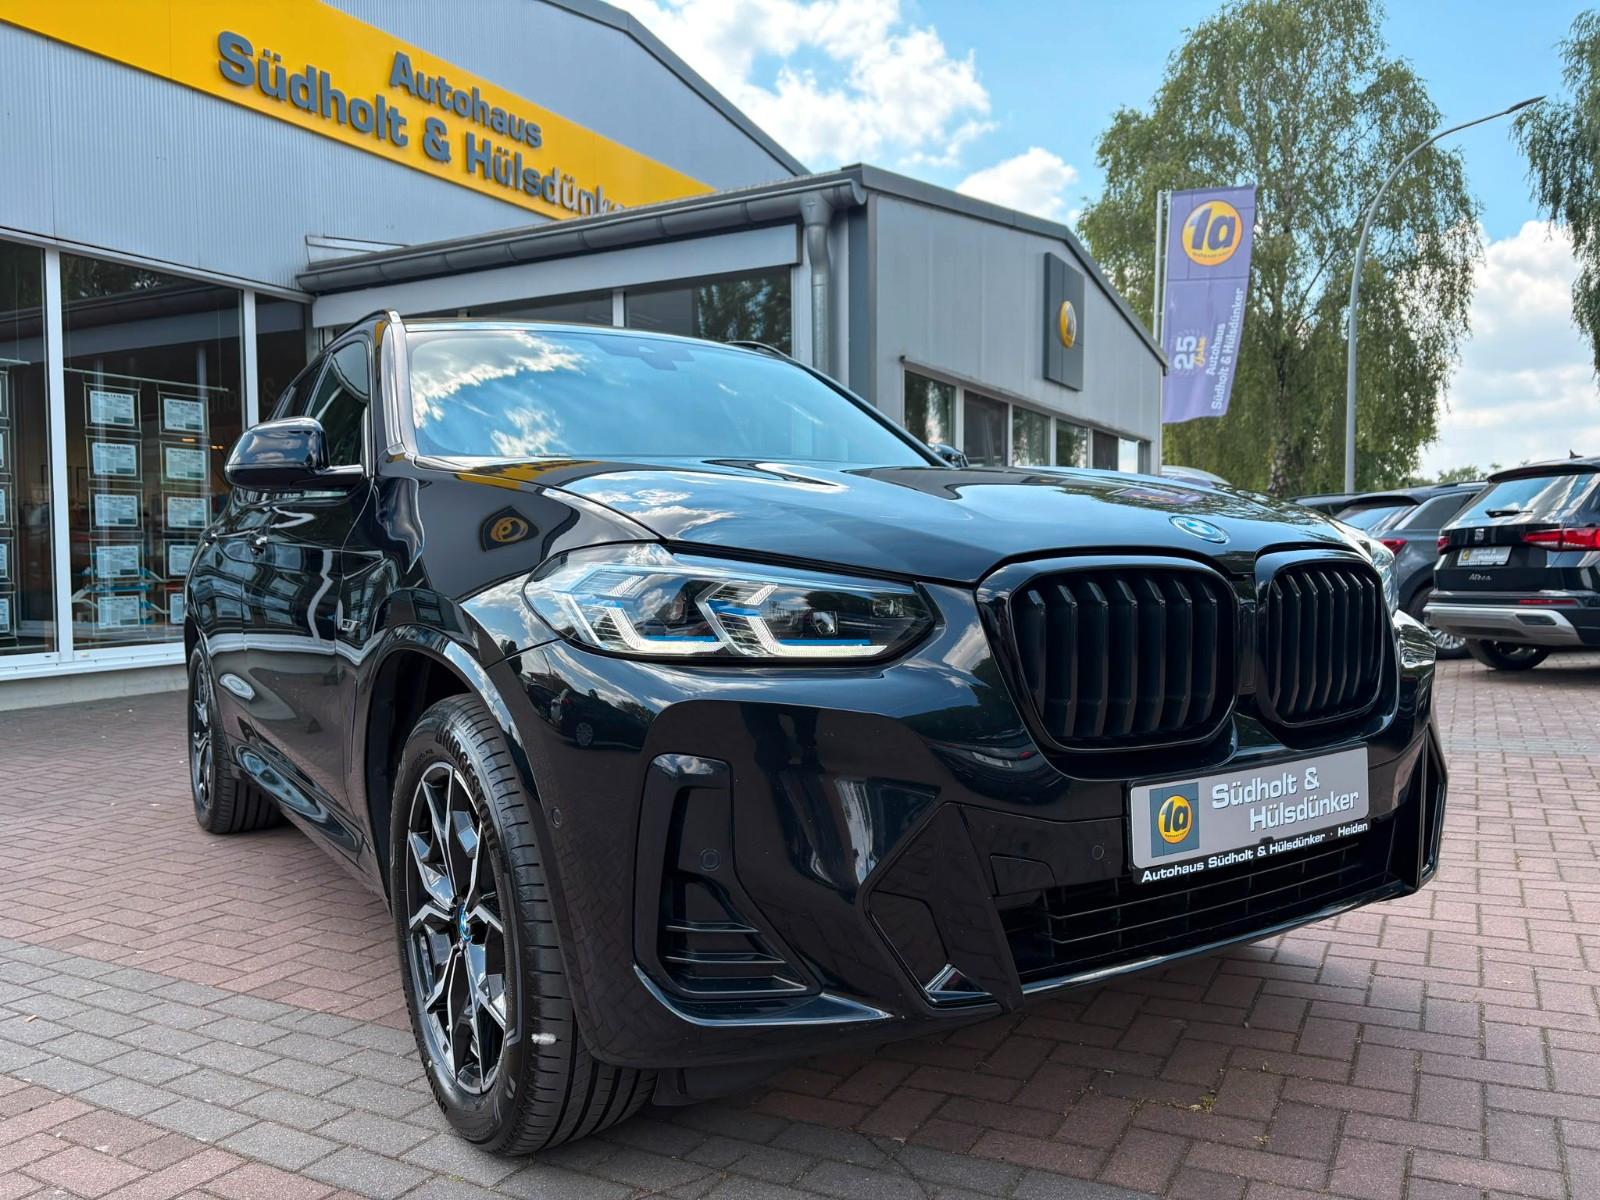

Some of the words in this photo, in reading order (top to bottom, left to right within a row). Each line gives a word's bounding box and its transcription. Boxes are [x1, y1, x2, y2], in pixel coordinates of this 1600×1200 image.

[217, 30, 409, 148] Südholt
[423, 117, 451, 163] &
[465, 132, 625, 217] Hülsdünk
[390, 51, 543, 148] Autohaus
[1223, 287, 1244, 354] Hülsdünker
[1175, 335, 1197, 370] 25
[1206, 323, 1226, 376] Autohaus
[1222, 355, 1232, 365] &
[1211, 366, 1230, 410] Südholt
[1211, 772, 1297, 810] Südholt
[1304, 766, 1320, 790] &
[1249, 790, 1359, 833] Hülsdünker
[1141, 860, 1205, 884] Autohaus
[1208, 848, 1254, 869] Südholt
[1257, 845, 1267, 858] &
[1269, 832, 1326, 855] Hülsdünker
[1337, 821, 1368, 838] Heiden
